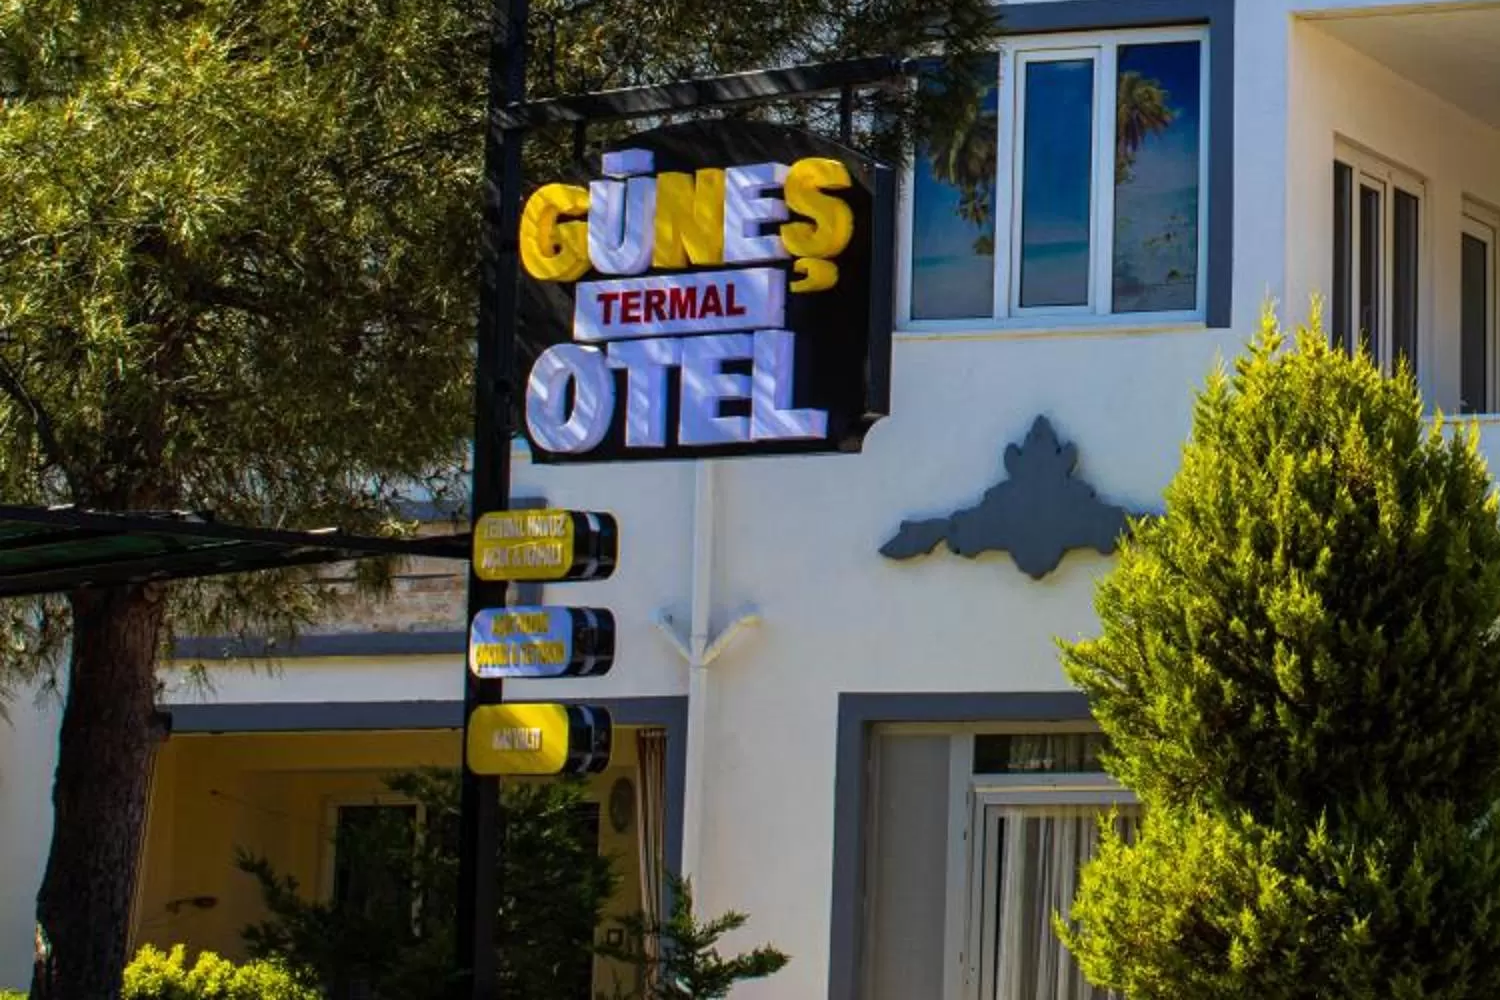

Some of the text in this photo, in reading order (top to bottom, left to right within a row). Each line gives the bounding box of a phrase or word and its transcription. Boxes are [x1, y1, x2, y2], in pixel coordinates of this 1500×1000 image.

[520, 148, 854, 293] GÜNEŞ
[597, 283, 747, 326] TERMAL
[526, 330, 829, 454] OTEL
